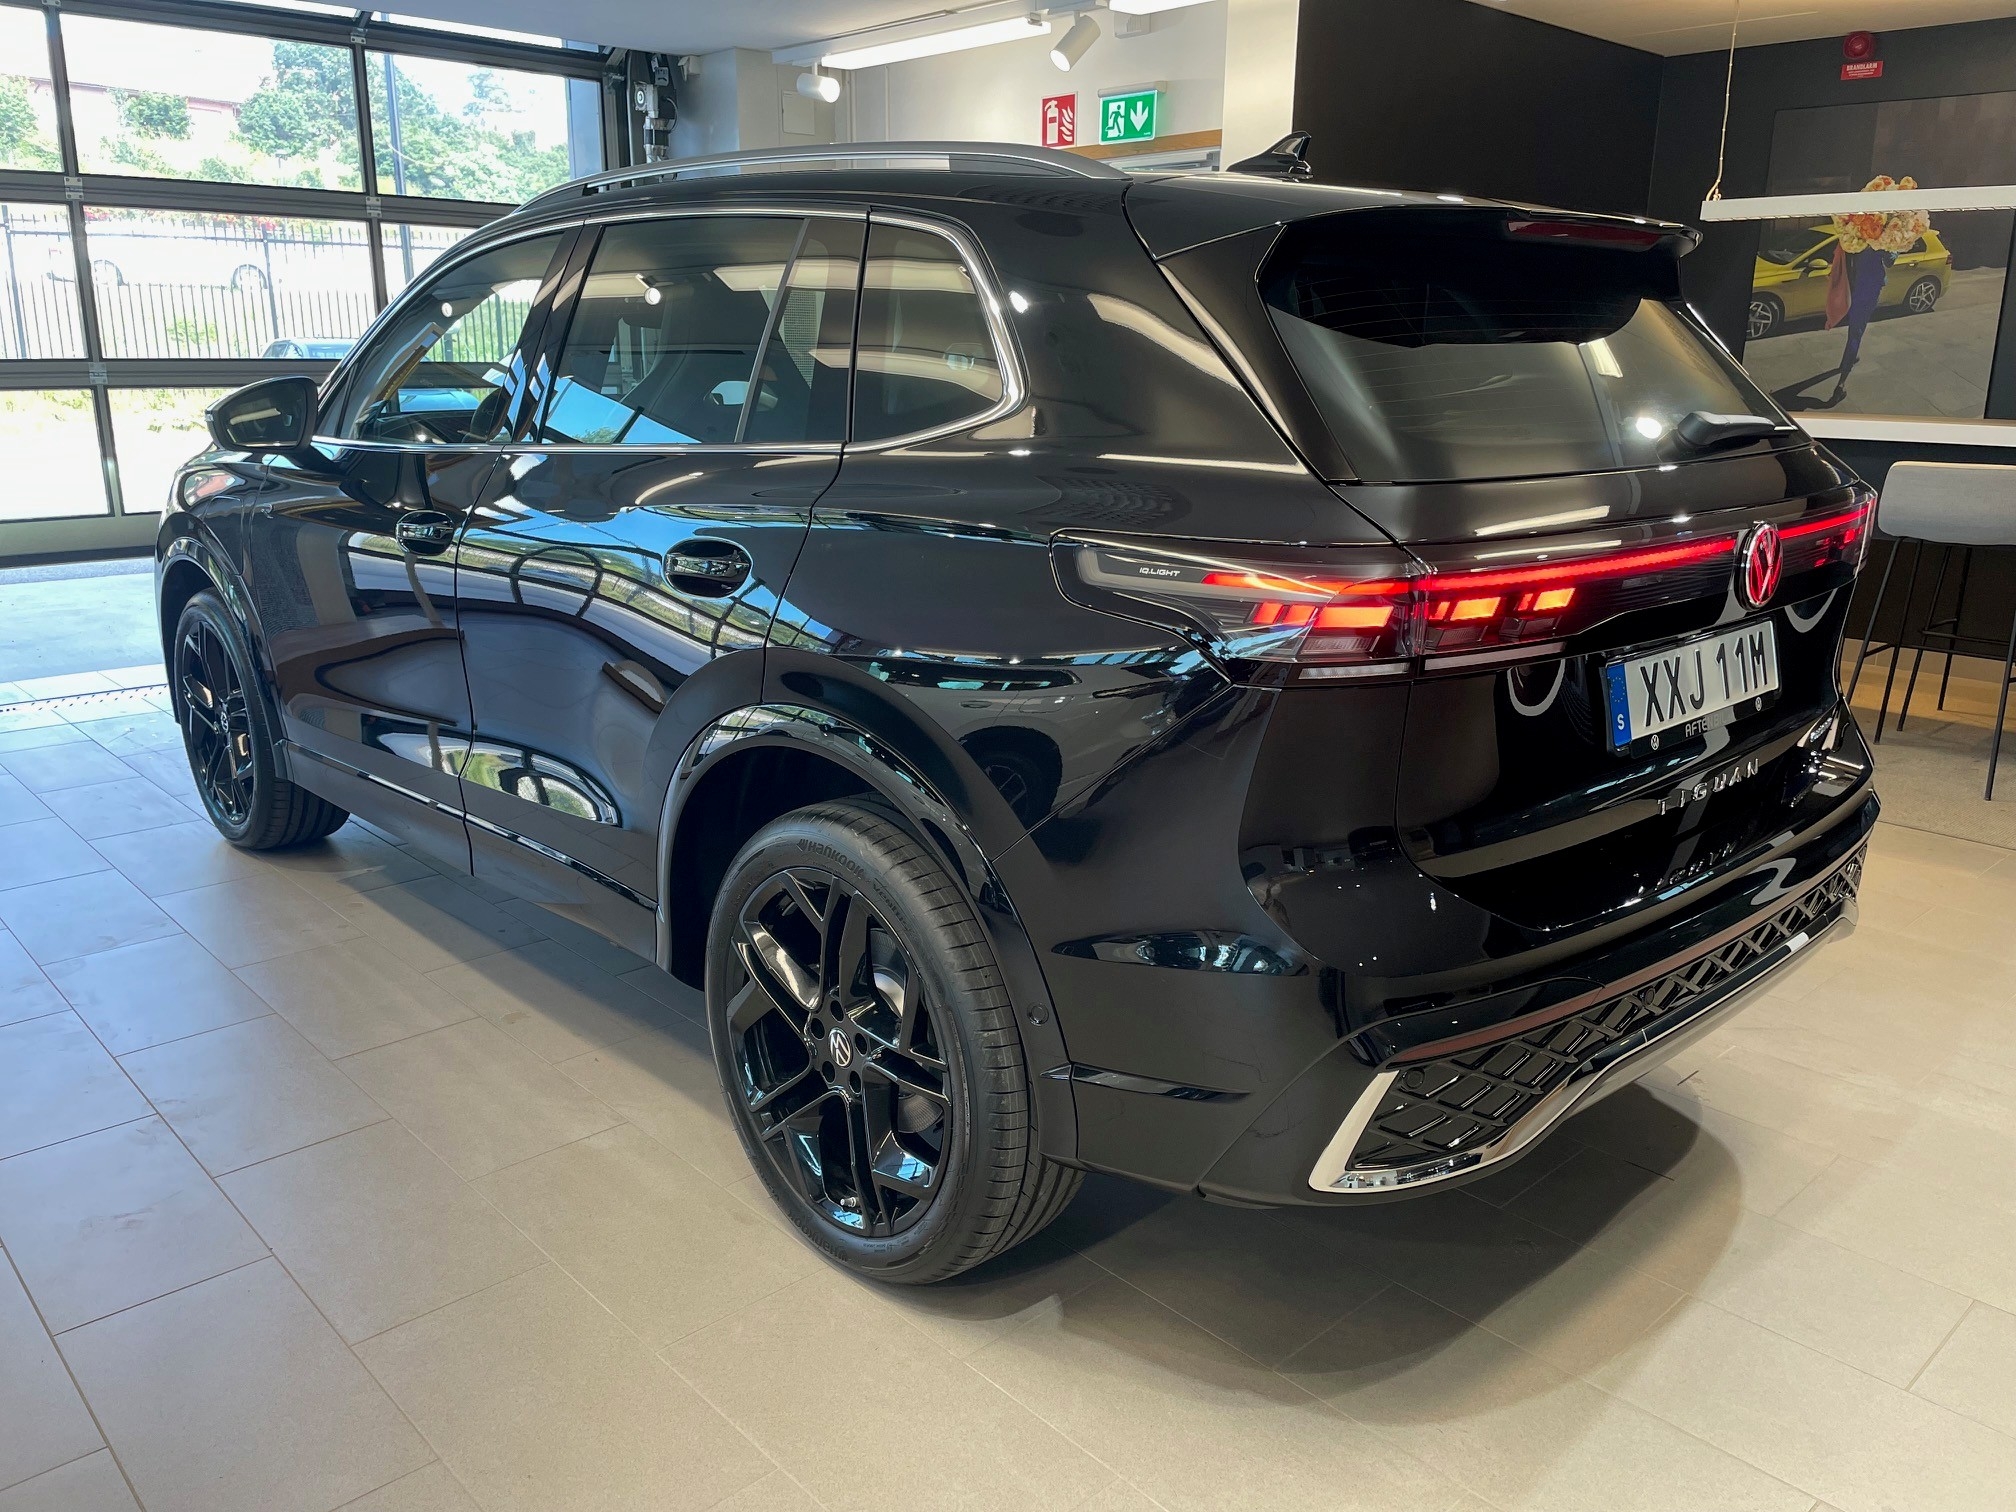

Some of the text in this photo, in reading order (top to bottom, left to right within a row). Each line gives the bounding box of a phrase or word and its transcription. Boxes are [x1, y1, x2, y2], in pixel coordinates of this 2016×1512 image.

[1640, 631, 1768, 728] XXJ 11M
[1617, 713, 1625, 730] S
[1657, 758, 1759, 816] TIGUAN
